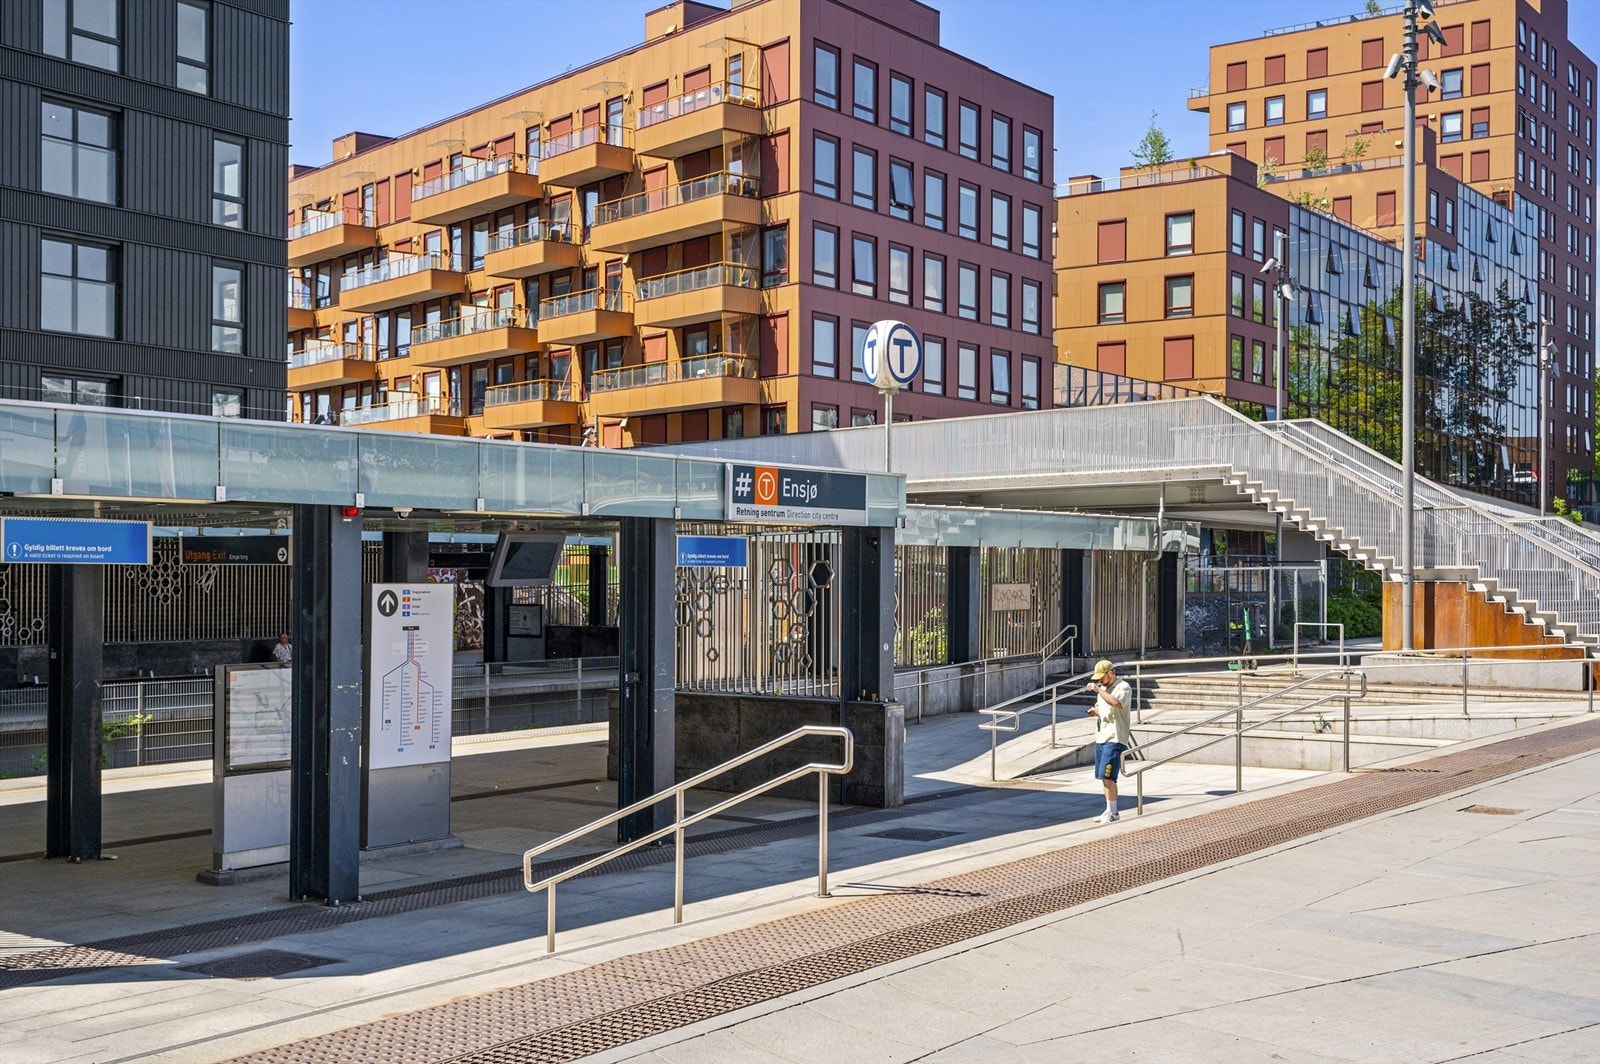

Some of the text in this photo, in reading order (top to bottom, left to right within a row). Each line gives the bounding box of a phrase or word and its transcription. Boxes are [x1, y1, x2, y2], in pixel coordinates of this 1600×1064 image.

[867, 338, 877, 375] T
[892, 337, 913, 374] T
[782, 477, 818, 503] Ensjø
[736, 506, 839, 521] Retning sentrum Direction city centre
[24, 543, 45, 552] Gyldig
[45, 544, 65, 552] billett
[65, 544, 86, 552] kreves
[184, 549, 211, 562] Utgang
[212, 549, 227, 560] Exit
